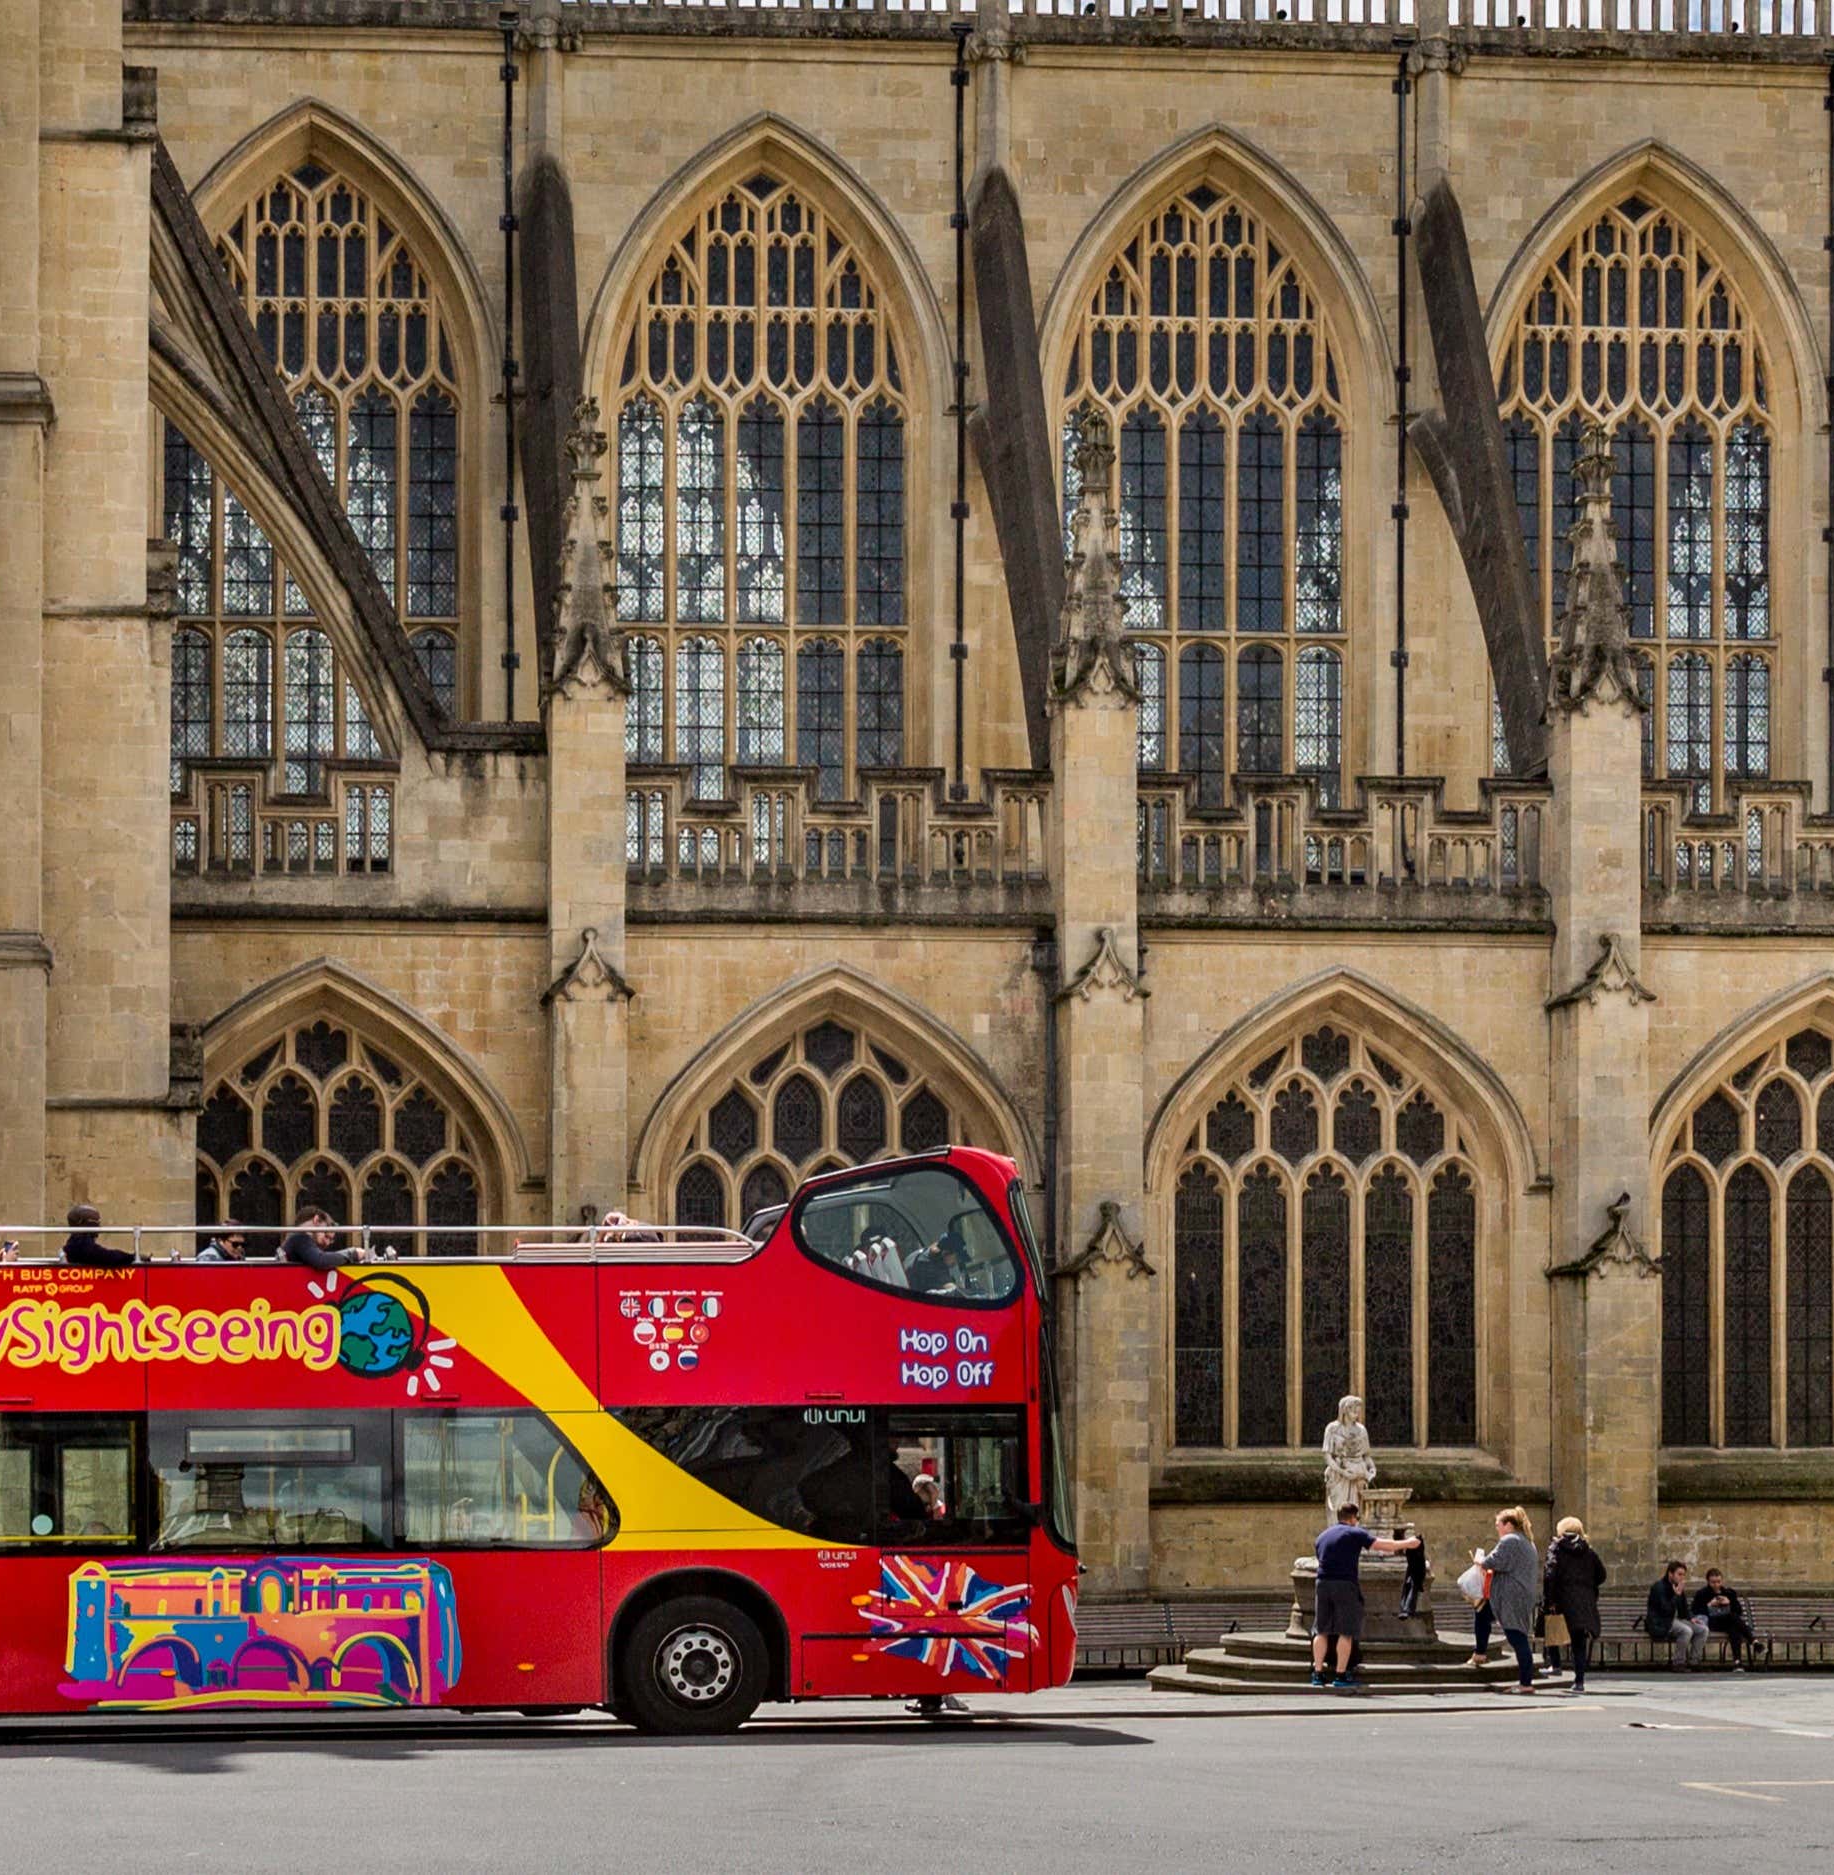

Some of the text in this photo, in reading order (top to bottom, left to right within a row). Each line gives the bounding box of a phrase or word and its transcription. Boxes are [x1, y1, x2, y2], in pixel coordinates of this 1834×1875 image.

[20, 1269, 53, 1281] BUS
[58, 1268, 136, 1281] COMPANY
[12, 1284, 94, 1294] RATP GROUP
[900, 1327, 987, 1356] Hop On
[901, 1360, 994, 1389] Hop Off
